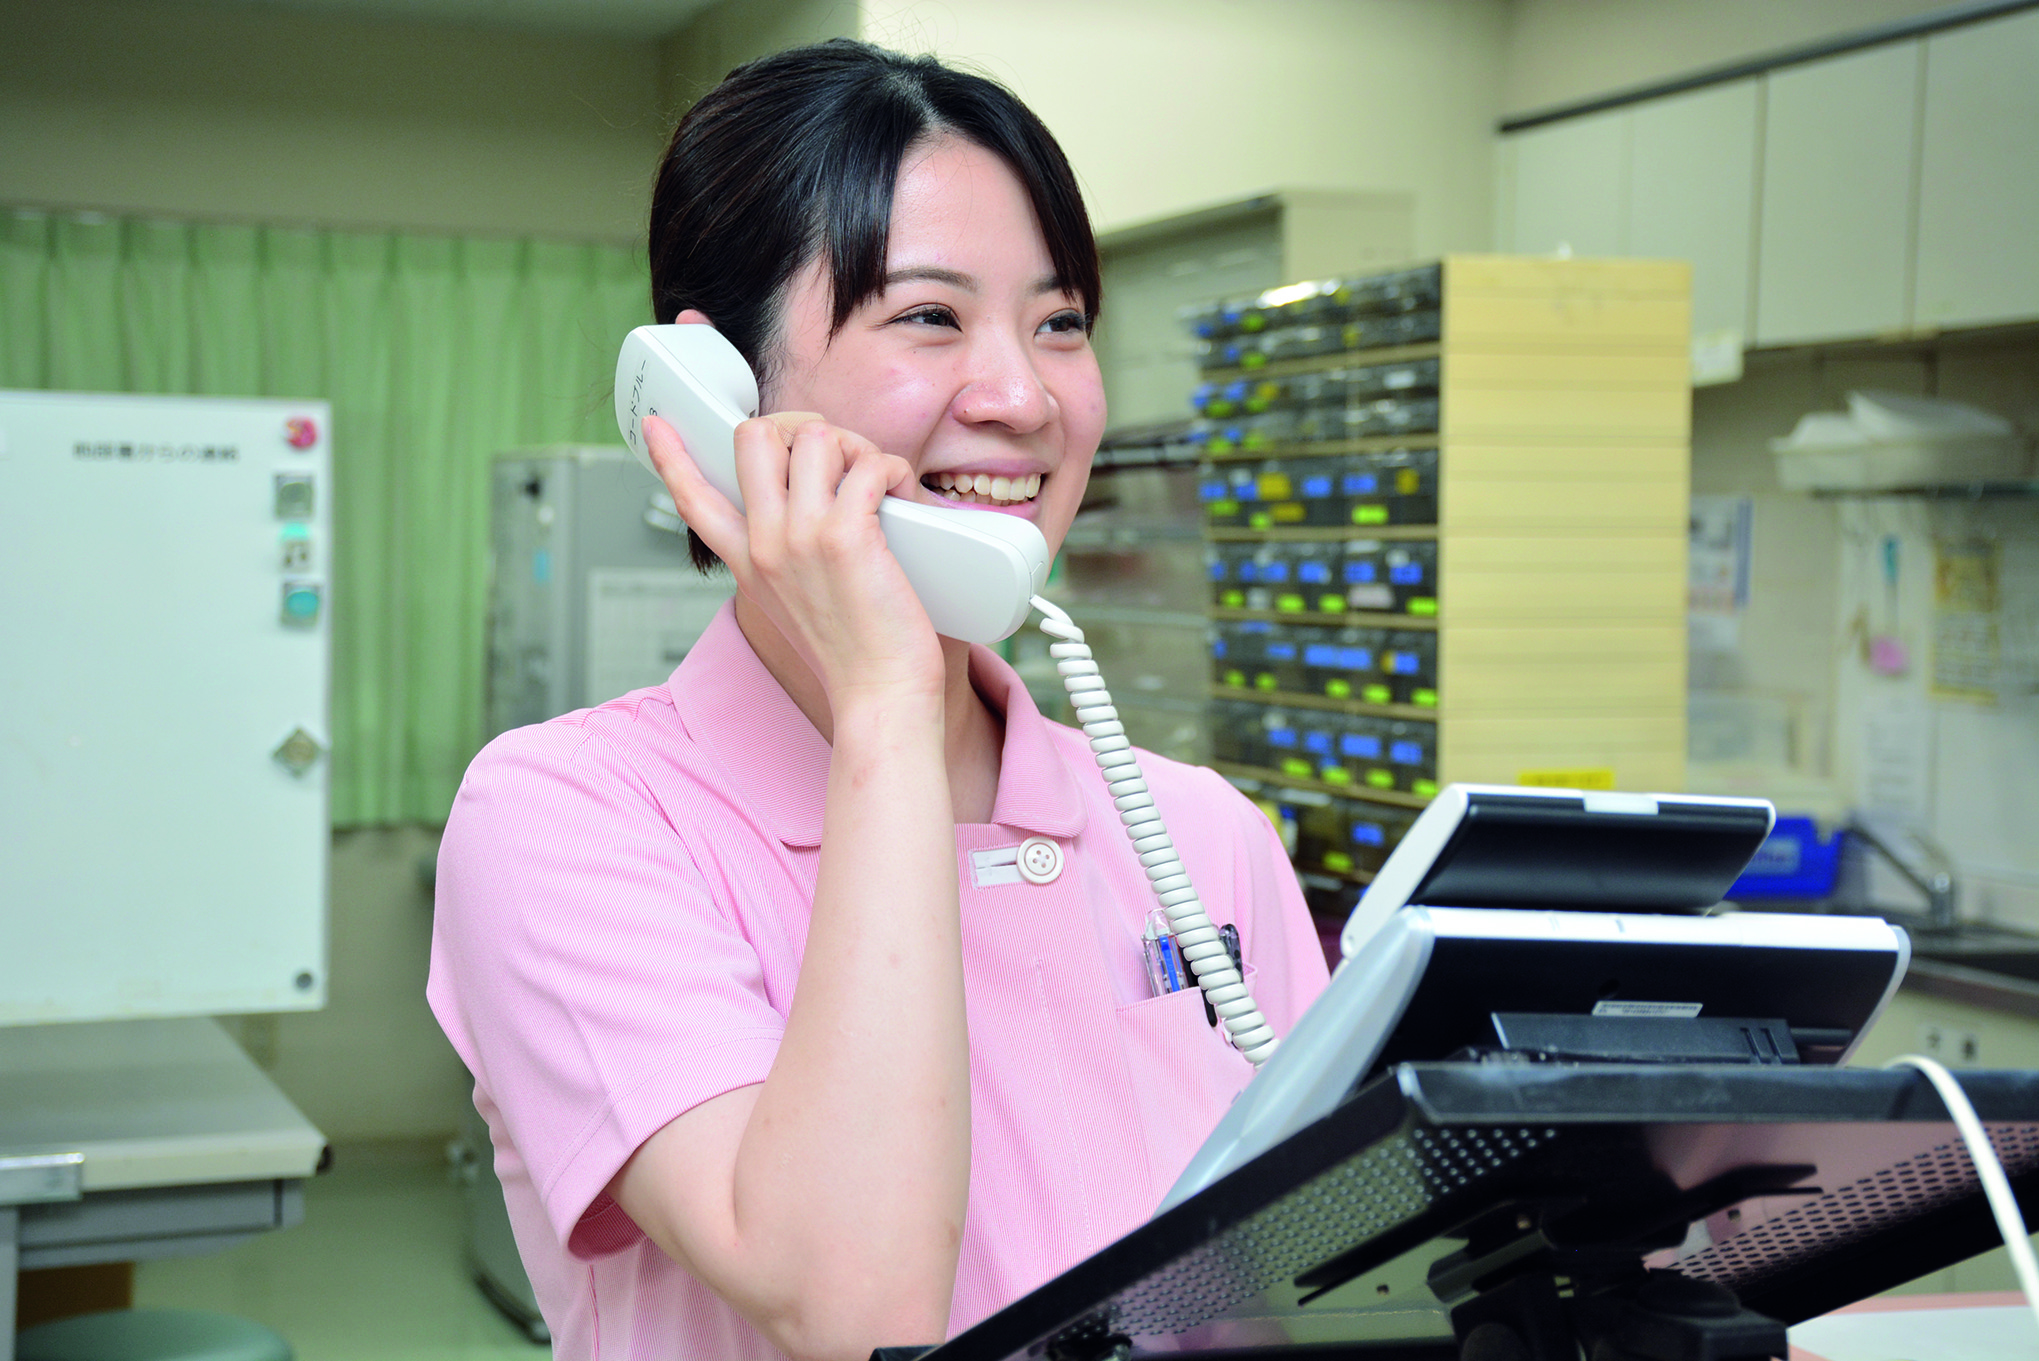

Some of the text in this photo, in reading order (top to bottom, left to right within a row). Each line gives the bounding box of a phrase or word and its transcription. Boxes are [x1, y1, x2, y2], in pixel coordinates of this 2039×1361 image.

[630, 360, 646, 445] コードブルー
